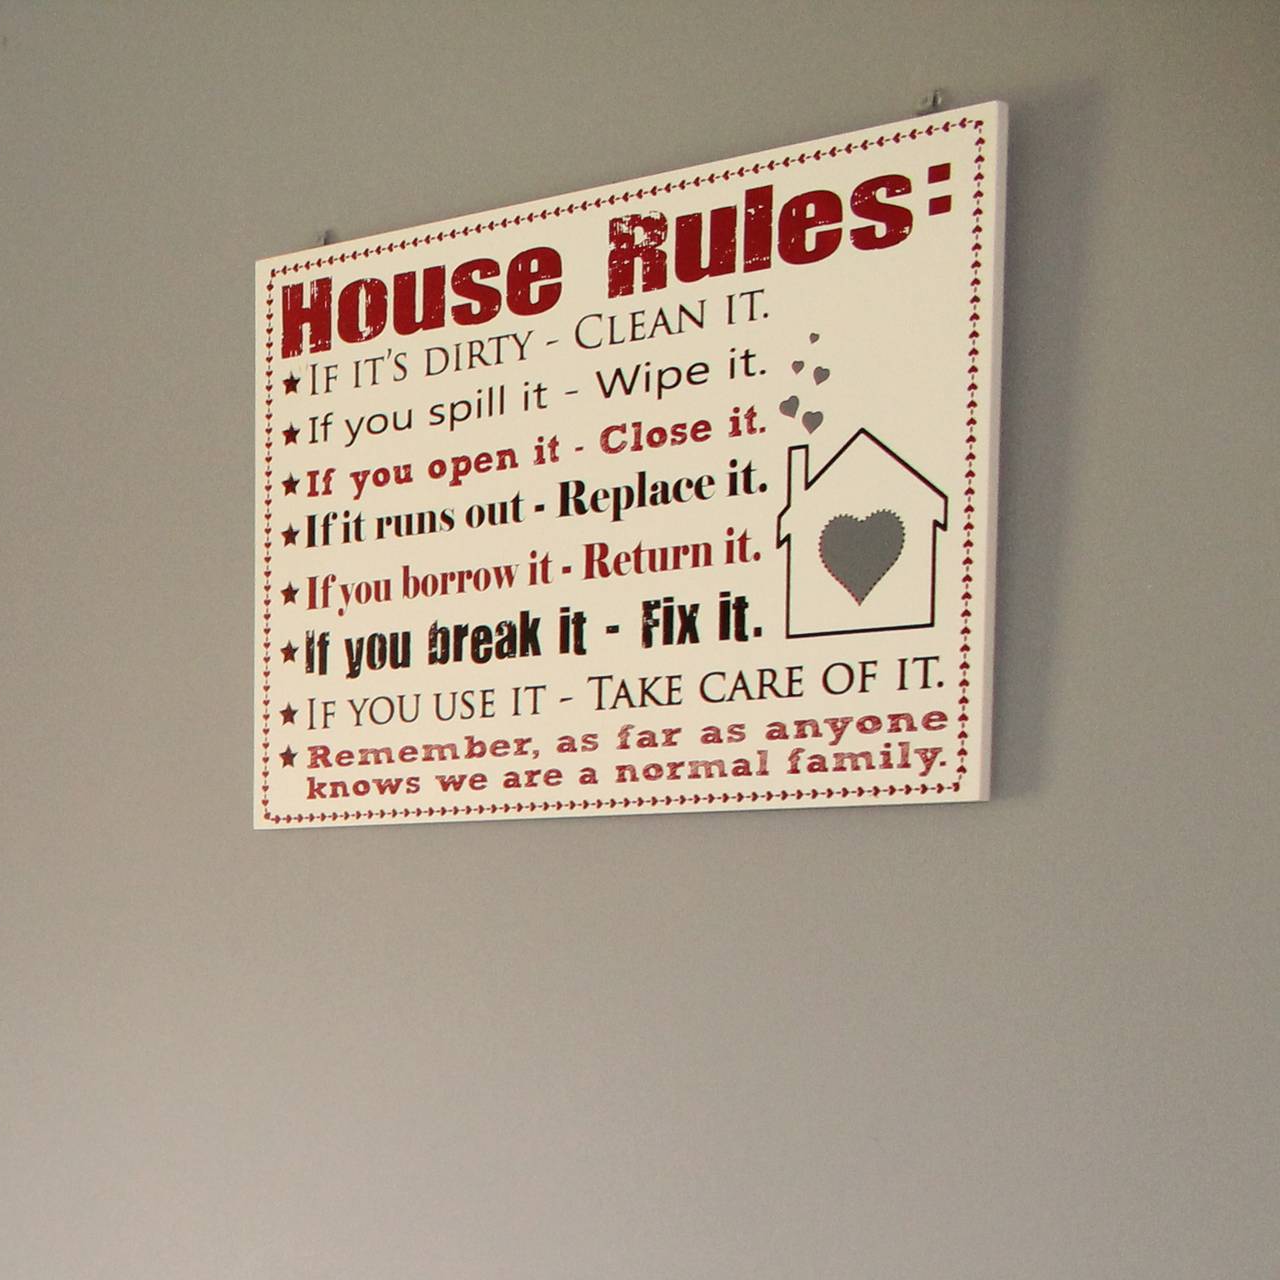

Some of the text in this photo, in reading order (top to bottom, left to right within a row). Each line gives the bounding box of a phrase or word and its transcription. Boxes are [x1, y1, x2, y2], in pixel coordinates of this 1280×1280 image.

[279, 160, 954, 361] House Rules:
[308, 362, 340, 398] IF
[352, 346, 409, 390] IT'S
[423, 328, 536, 378] DIRTY
[573, 298, 708, 351] CLEAN
[724, 287, 770, 327] IT.
[307, 410, 335, 446] If
[342, 407, 414, 449] you
[427, 383, 506, 433] spill
[522, 379, 550, 413] it
[594, 360, 712, 402] Wipe
[728, 346, 768, 381] it.
[305, 466, 338, 499] If
[348, 462, 415, 503] you
[426, 447, 520, 489] open
[532, 433, 561, 467] it
[598, 418, 714, 456] Close
[727, 403, 767, 439] it.
[303, 510, 339, 550] If
[340, 508, 367, 546] it
[374, 507, 456, 542] runs
[463, 489, 526, 530] out
[554, 469, 717, 524] Replace
[725, 457, 769, 498] it.
[305, 572, 338, 612] If
[336, 577, 393, 618] you
[400, 562, 521, 601] borrow
[527, 548, 554, 588] it
[581, 539, 714, 582] Return
[723, 525, 763, 566] it.
[303, 628, 331, 678] If
[343, 629, 412, 681] you
[426, 609, 543, 667] break
[557, 605, 588, 658] it
[640, 594, 702, 651] Fix
[717, 589, 764, 644] it.
[306, 696, 337, 732] IF
[346, 692, 423, 728] YOU
[432, 687, 497, 723] USE
[510, 683, 548, 718] IT
[585, 673, 684, 712] TAKE
[698, 664, 805, 705] CARE
[820, 658, 880, 697] OF
[895, 654, 945, 692] IT.
[305, 709, 950, 771] Remember, as far as anyone
[305, 740, 948, 801] knows we are a normal family.
